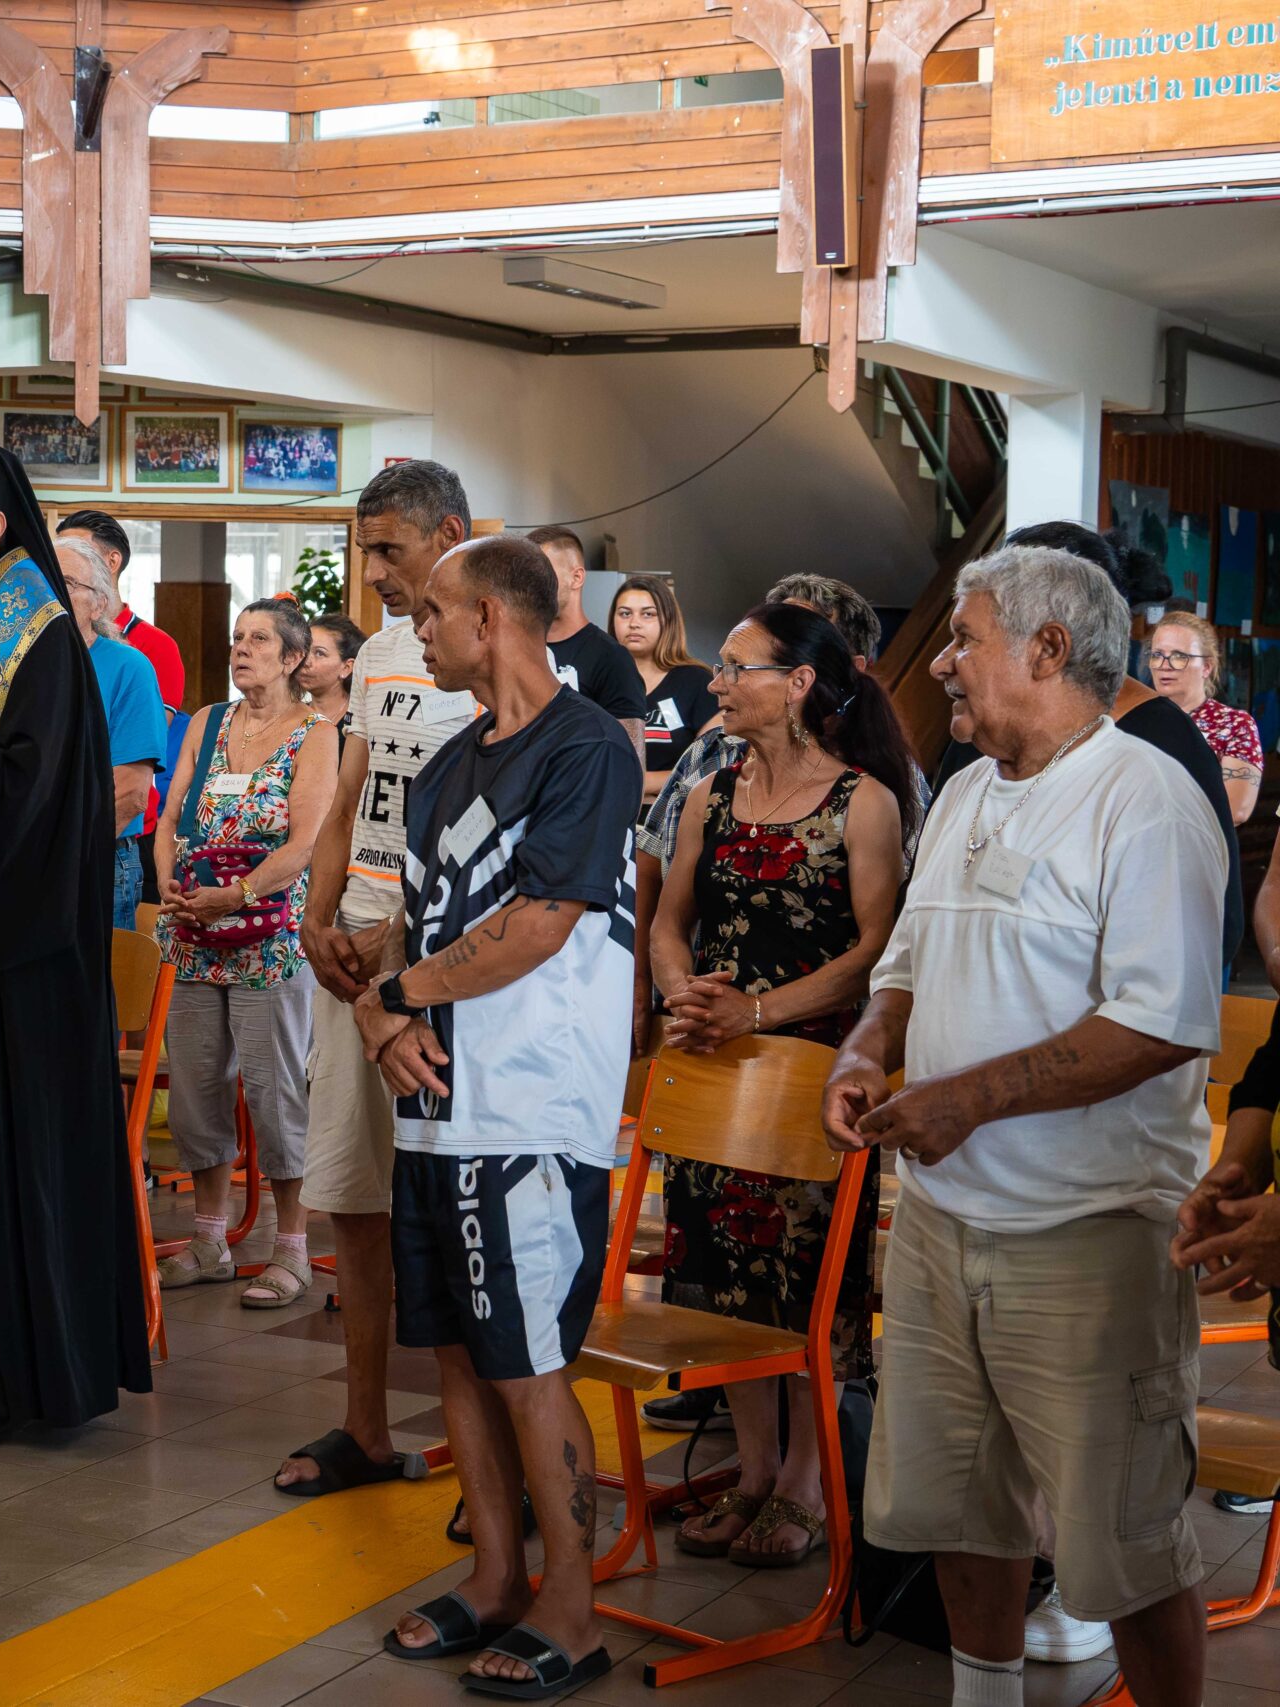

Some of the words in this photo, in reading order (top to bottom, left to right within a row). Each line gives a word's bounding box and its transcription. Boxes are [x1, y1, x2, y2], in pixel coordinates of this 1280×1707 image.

[1226, 16, 1280, 48] em
[1048, 74, 1160, 117] jelenti
[1164, 78, 1185, 102] a
[355, 848, 407, 870] BROOKLYN
